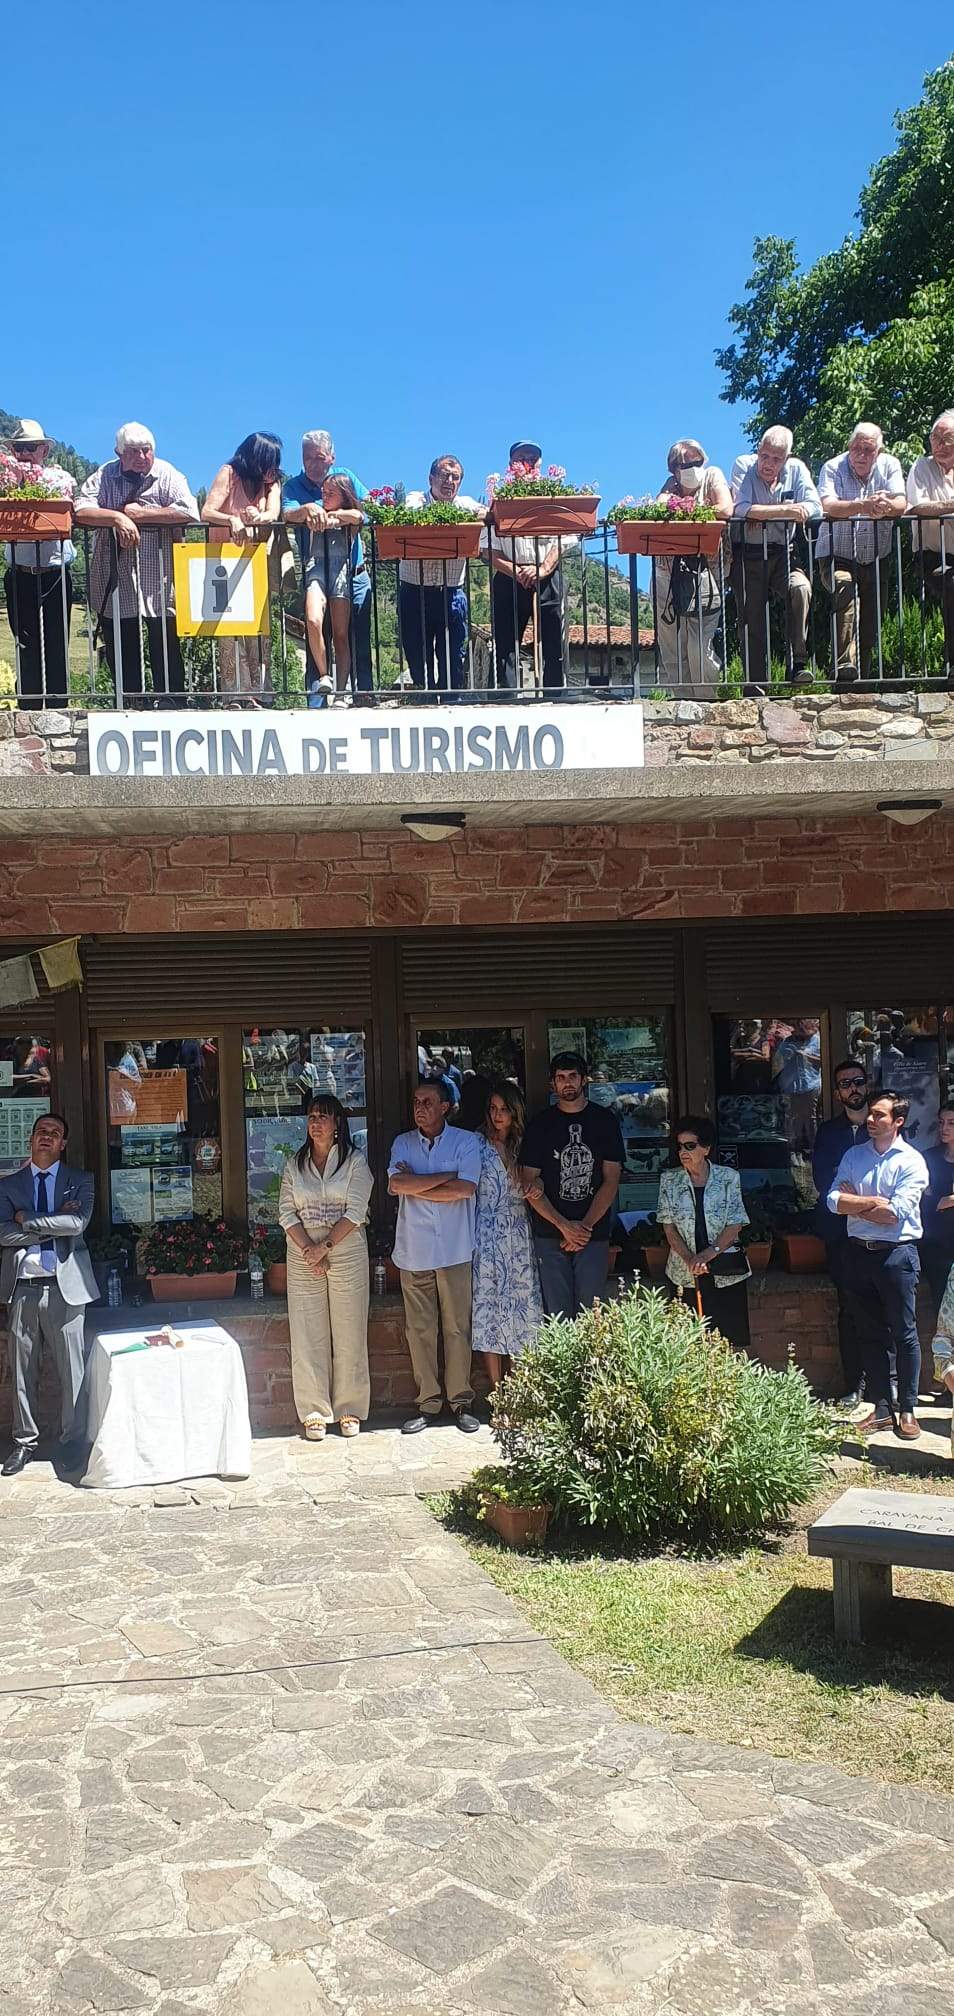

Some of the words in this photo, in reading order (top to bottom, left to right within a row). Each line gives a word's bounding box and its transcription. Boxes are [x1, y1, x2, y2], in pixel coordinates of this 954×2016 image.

[96, 729, 288, 776] OFICINA
[302, 737, 350, 775] DE
[360, 724, 565, 773] TURISMO
[860, 1508, 944, 1522] CARAVANA
[868, 1519, 893, 1527] BAL
